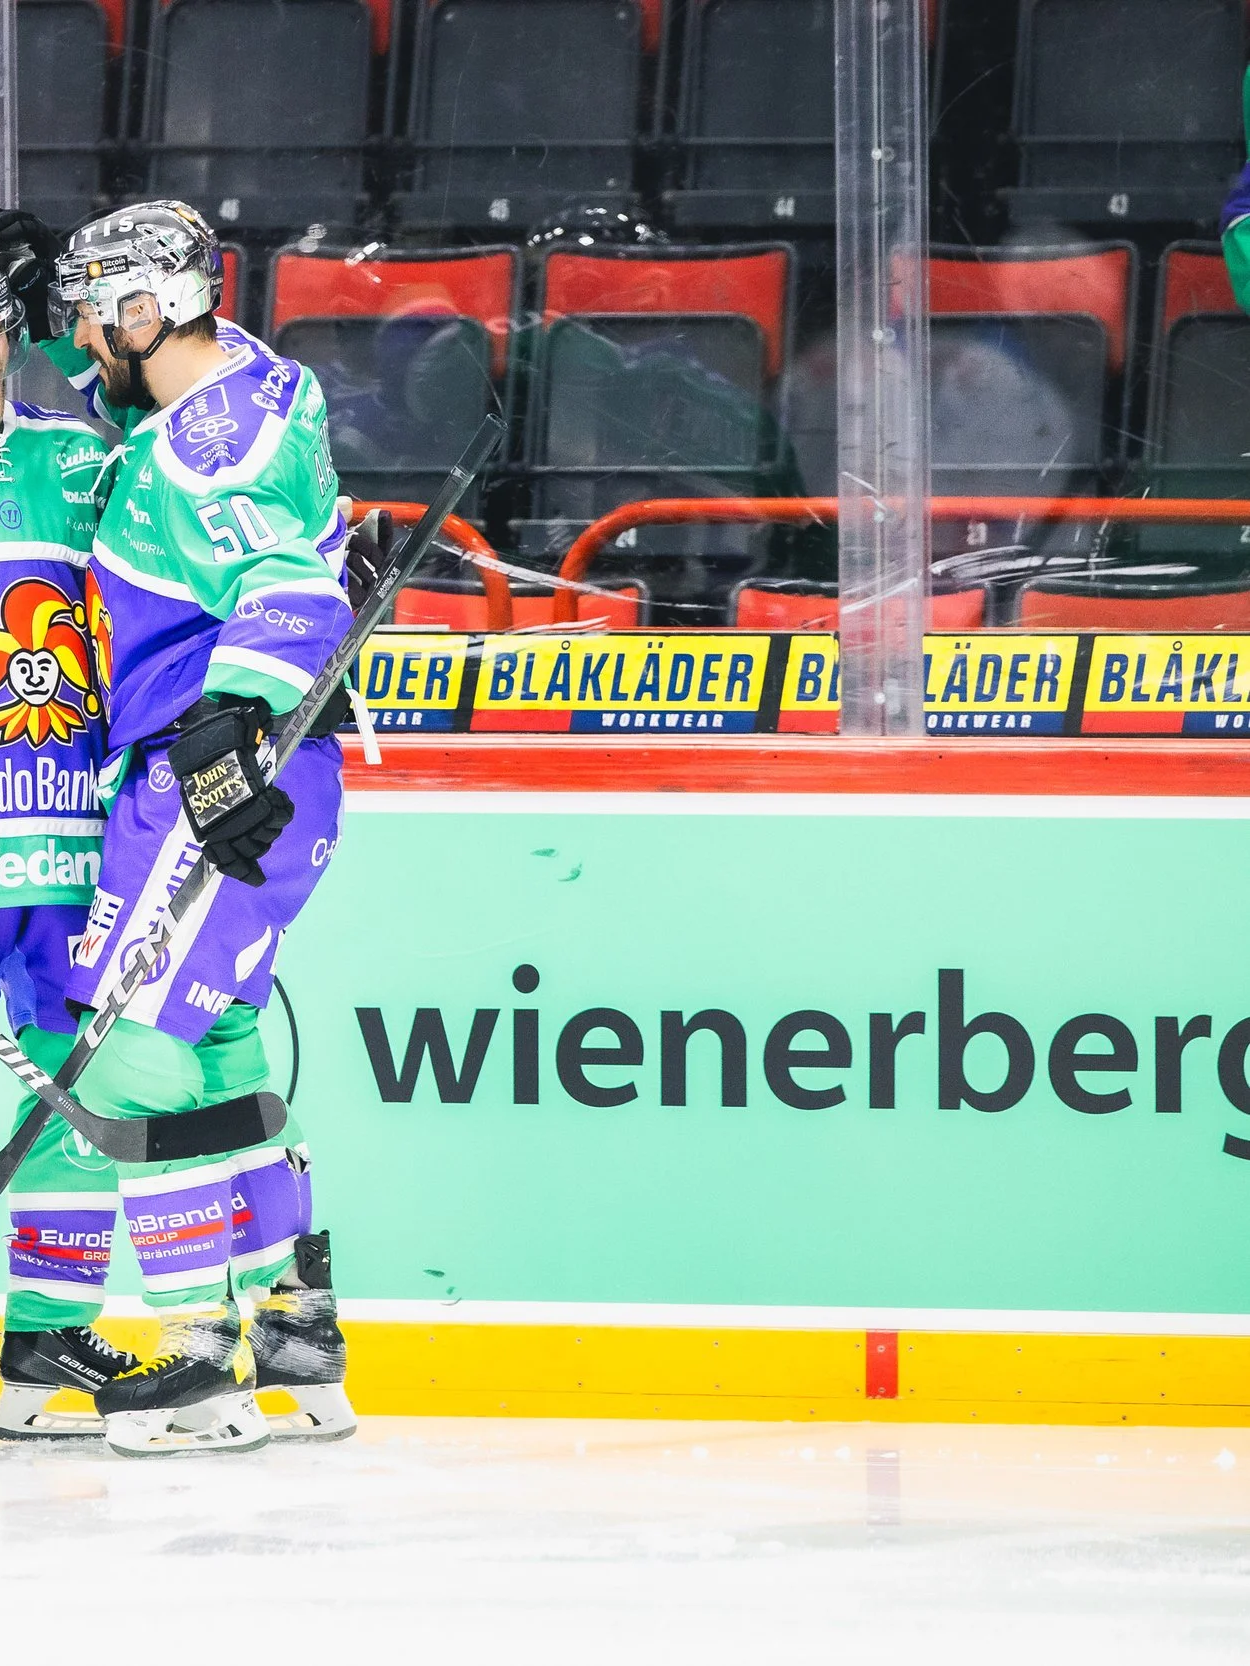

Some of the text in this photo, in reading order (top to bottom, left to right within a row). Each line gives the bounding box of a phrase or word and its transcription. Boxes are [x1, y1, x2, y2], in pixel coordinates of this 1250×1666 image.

[196, 494, 280, 562] 50
[265, 608, 307, 635] CHS
[352, 651, 452, 701] DER
[488, 640, 756, 702] BLÅKLÄDER
[601, 713, 725, 728] WORKWEAR
[192, 762, 228, 792] JOHN
[192, 777, 243, 815] SCOTT'S
[83, 910, 180, 1049] CCM
